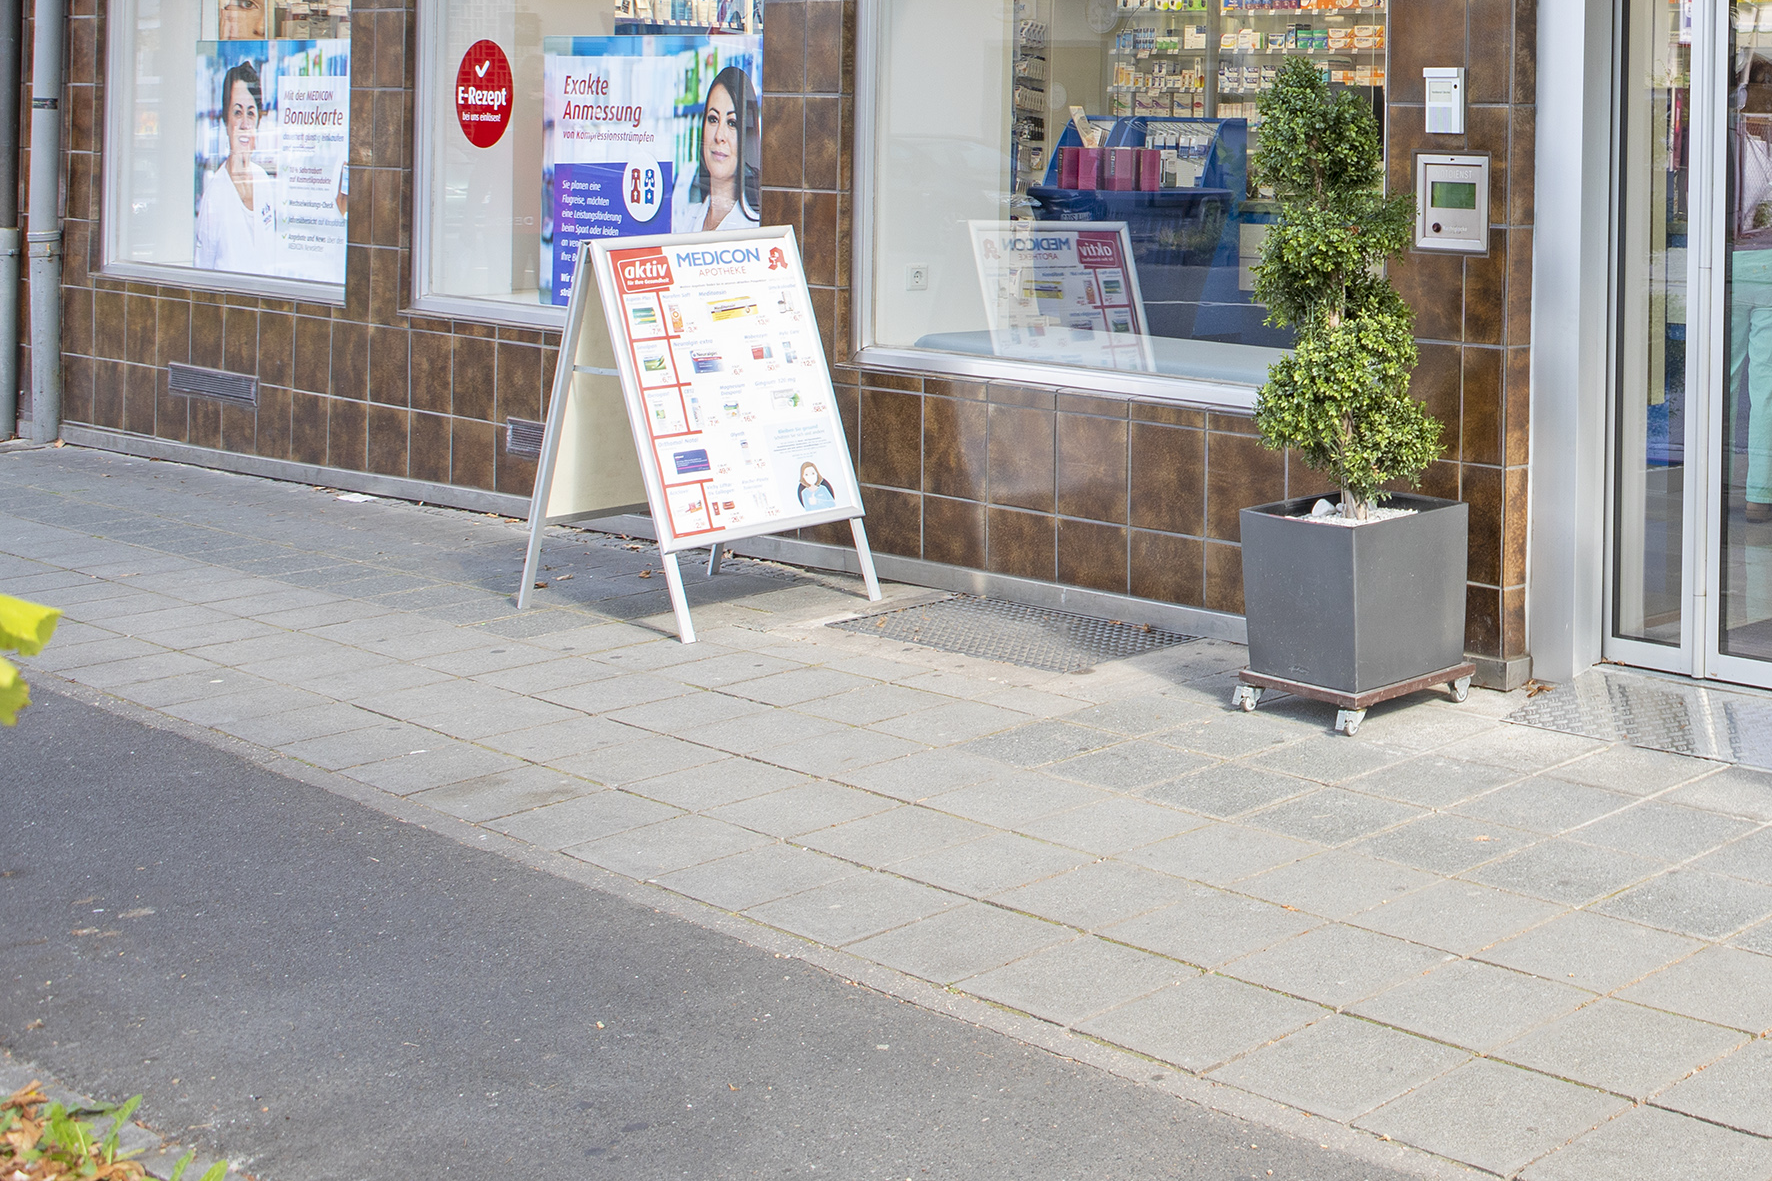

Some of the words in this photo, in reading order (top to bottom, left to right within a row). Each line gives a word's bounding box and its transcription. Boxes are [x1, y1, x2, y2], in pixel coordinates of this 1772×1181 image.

[564, 73, 609, 96] Exakte
[295, 90, 305, 101] der
[306, 91, 333, 101] MEDICON
[458, 86, 507, 110] E-Rezept
[284, 106, 344, 126] Bonuskarte
[462, 111, 470, 121] bei
[563, 101, 642, 128] Anmessung
[563, 131, 575, 139] von
[562, 180, 570, 189] Sie
[570, 180, 589, 191] planen
[589, 182, 602, 191] eine
[562, 194, 586, 206] Flugreise,
[586, 196, 610, 206] möchten
[562, 209, 574, 218] eine
[561, 223, 575, 233] beim
[575, 224, 589, 235] Sport
[589, 225, 602, 235] oder
[602, 226, 619, 236] leiden
[676, 248, 761, 267] MEDICON
[624, 260, 668, 279] aktiv
[698, 266, 747, 277] APOTHEKE
